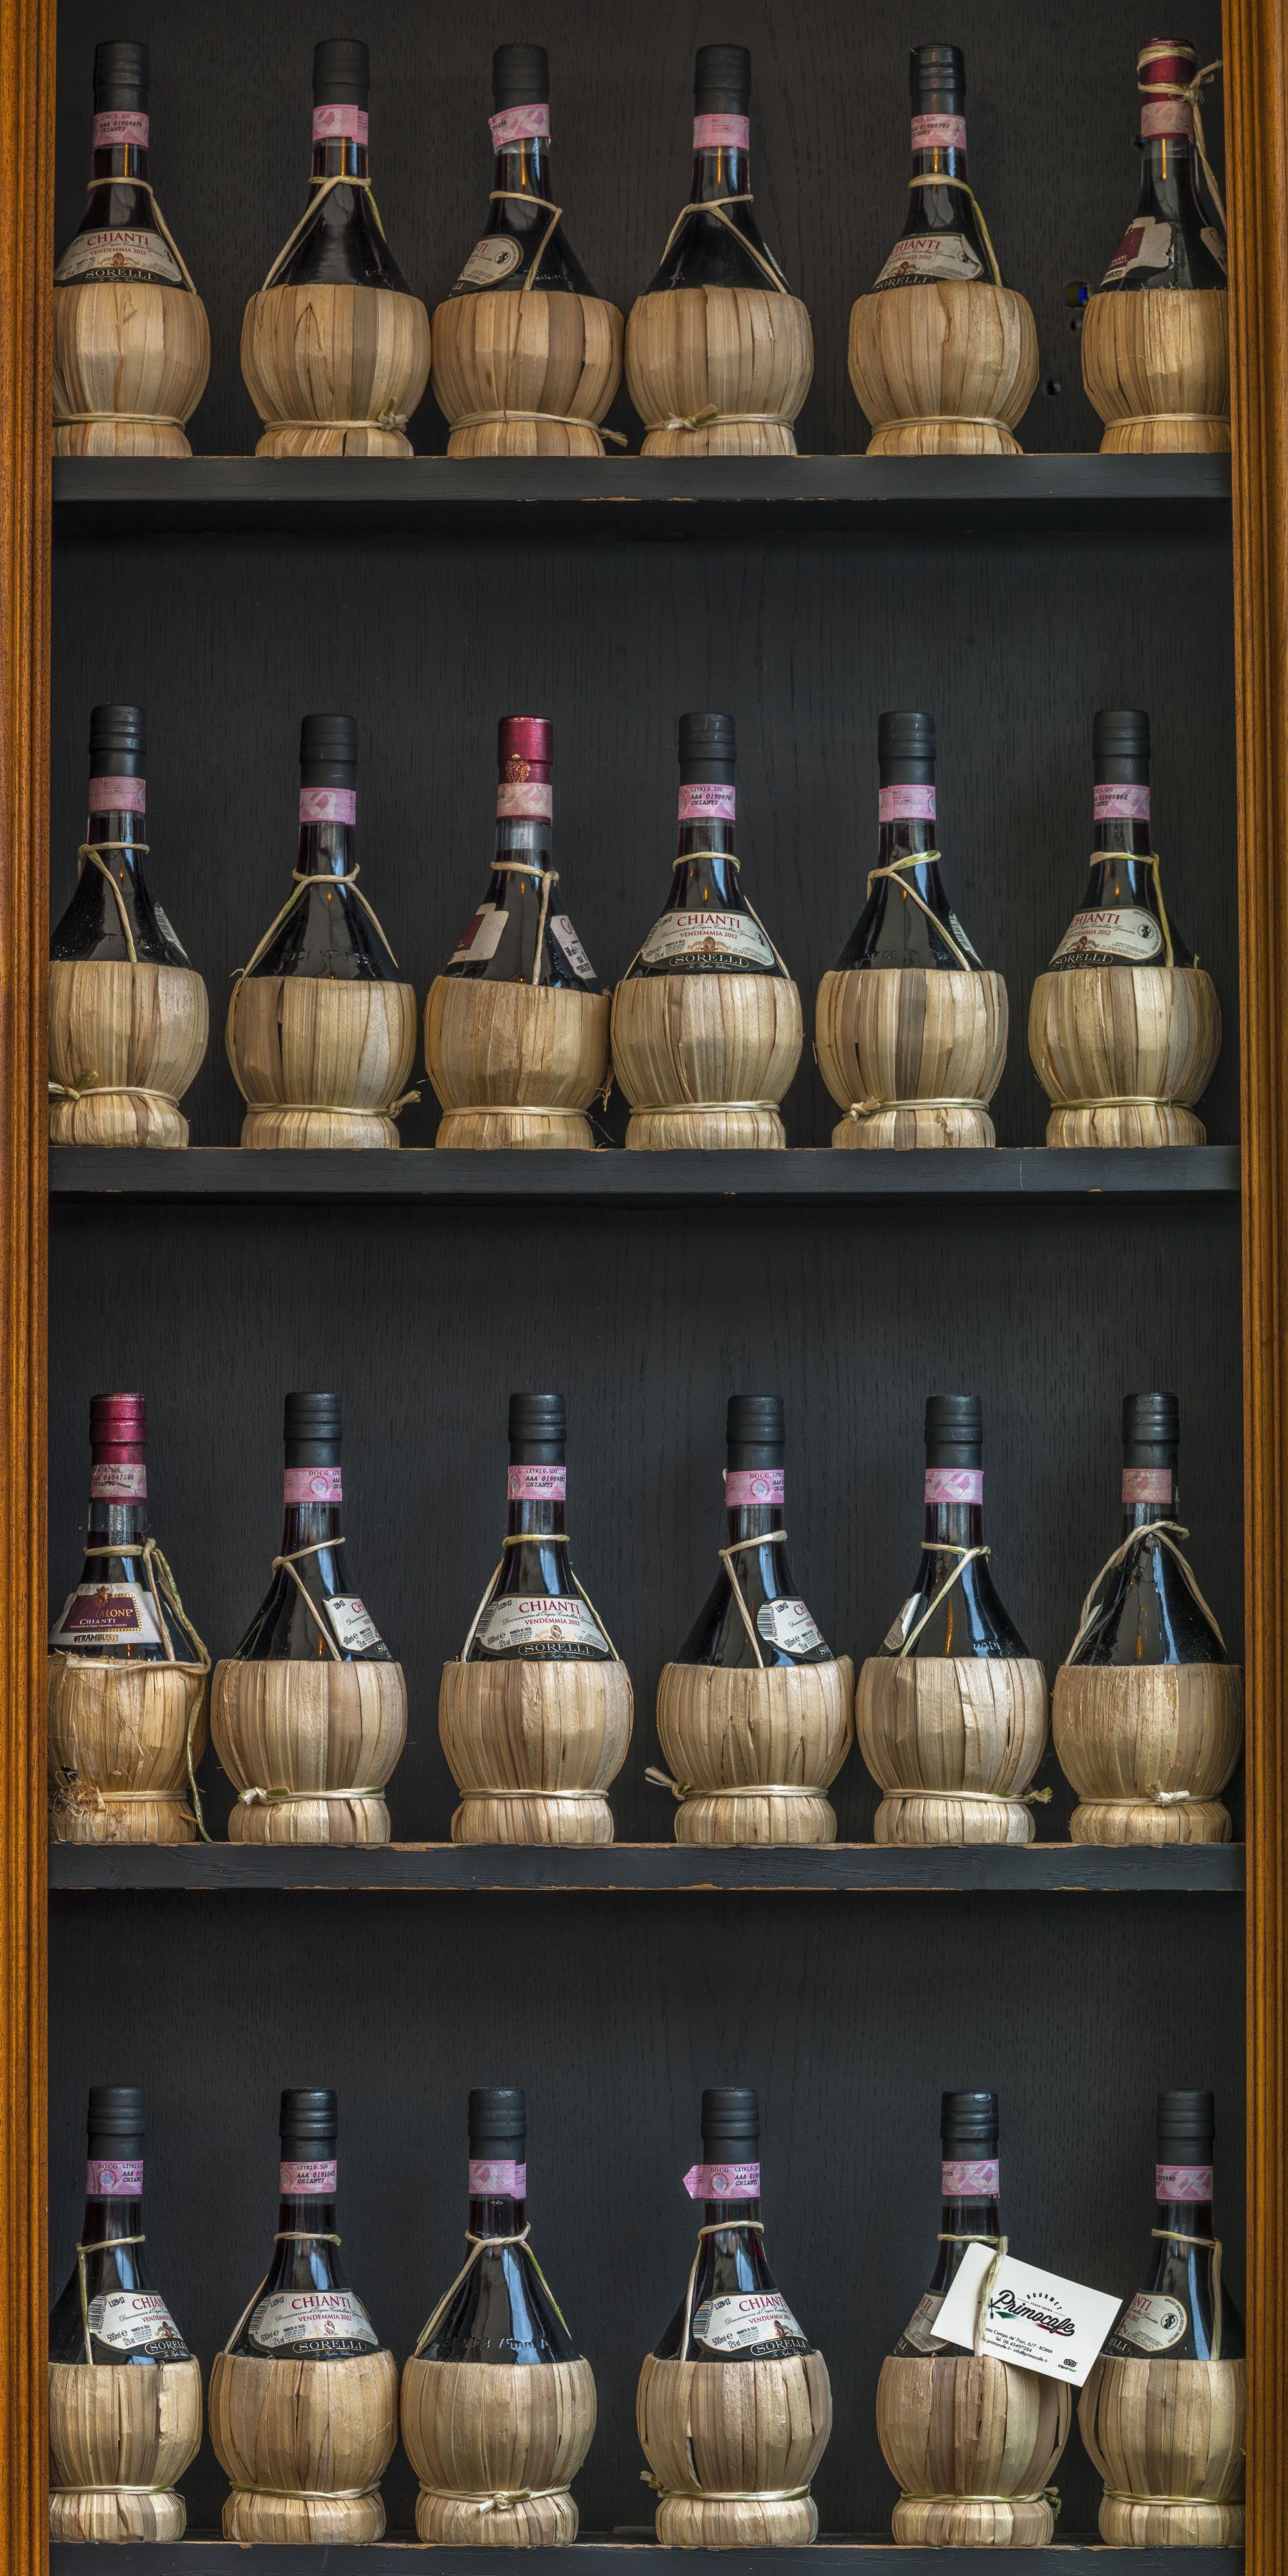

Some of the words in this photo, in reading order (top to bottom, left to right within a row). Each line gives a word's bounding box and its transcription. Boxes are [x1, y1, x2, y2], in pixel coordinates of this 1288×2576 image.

[87, 233, 150, 246] CHIANTI
[89, 247, 132, 256] VENDEMMIA
[85, 268, 152, 280] SORELLI
[677, 914, 741, 929] CHIANTI
[1070, 912, 1121, 929] CHIANTI
[1066, 930, 1096, 940] VENDEMMIA
[675, 953, 743, 965] SORELLI
[1054, 954, 1107, 966] SORELLI
[519, 1600, 581, 1614] CHIANTI
[75, 1634, 119, 1642] TRAMBUSTI
[525, 1643, 591, 1654] SORELLI
[291, 2296, 352, 2310] CHIANTI
[714, 2298, 731, 2310] L129/13
[1027, 2292, 1063, 2311] GOURMET
[992, 2289, 1075, 2336] Primocafe
[748, 2314, 784, 2324] VENDEMMIA
[107, 2332, 122, 2343] 500ml
[260, 2332, 273, 2343] 500ml
[712, 2335, 727, 2346] 500ml
[993, 2329, 1008, 2338] Campo
[1038, 2346, 1053, 2354] ROMA
[299, 2340, 363, 2351] SORELLI
[756, 2339, 806, 2353] SORELLI
[1010, 2341, 1033, 2353] 45497284
[1013, 2348, 1048, 2363] info@primocafe.it
